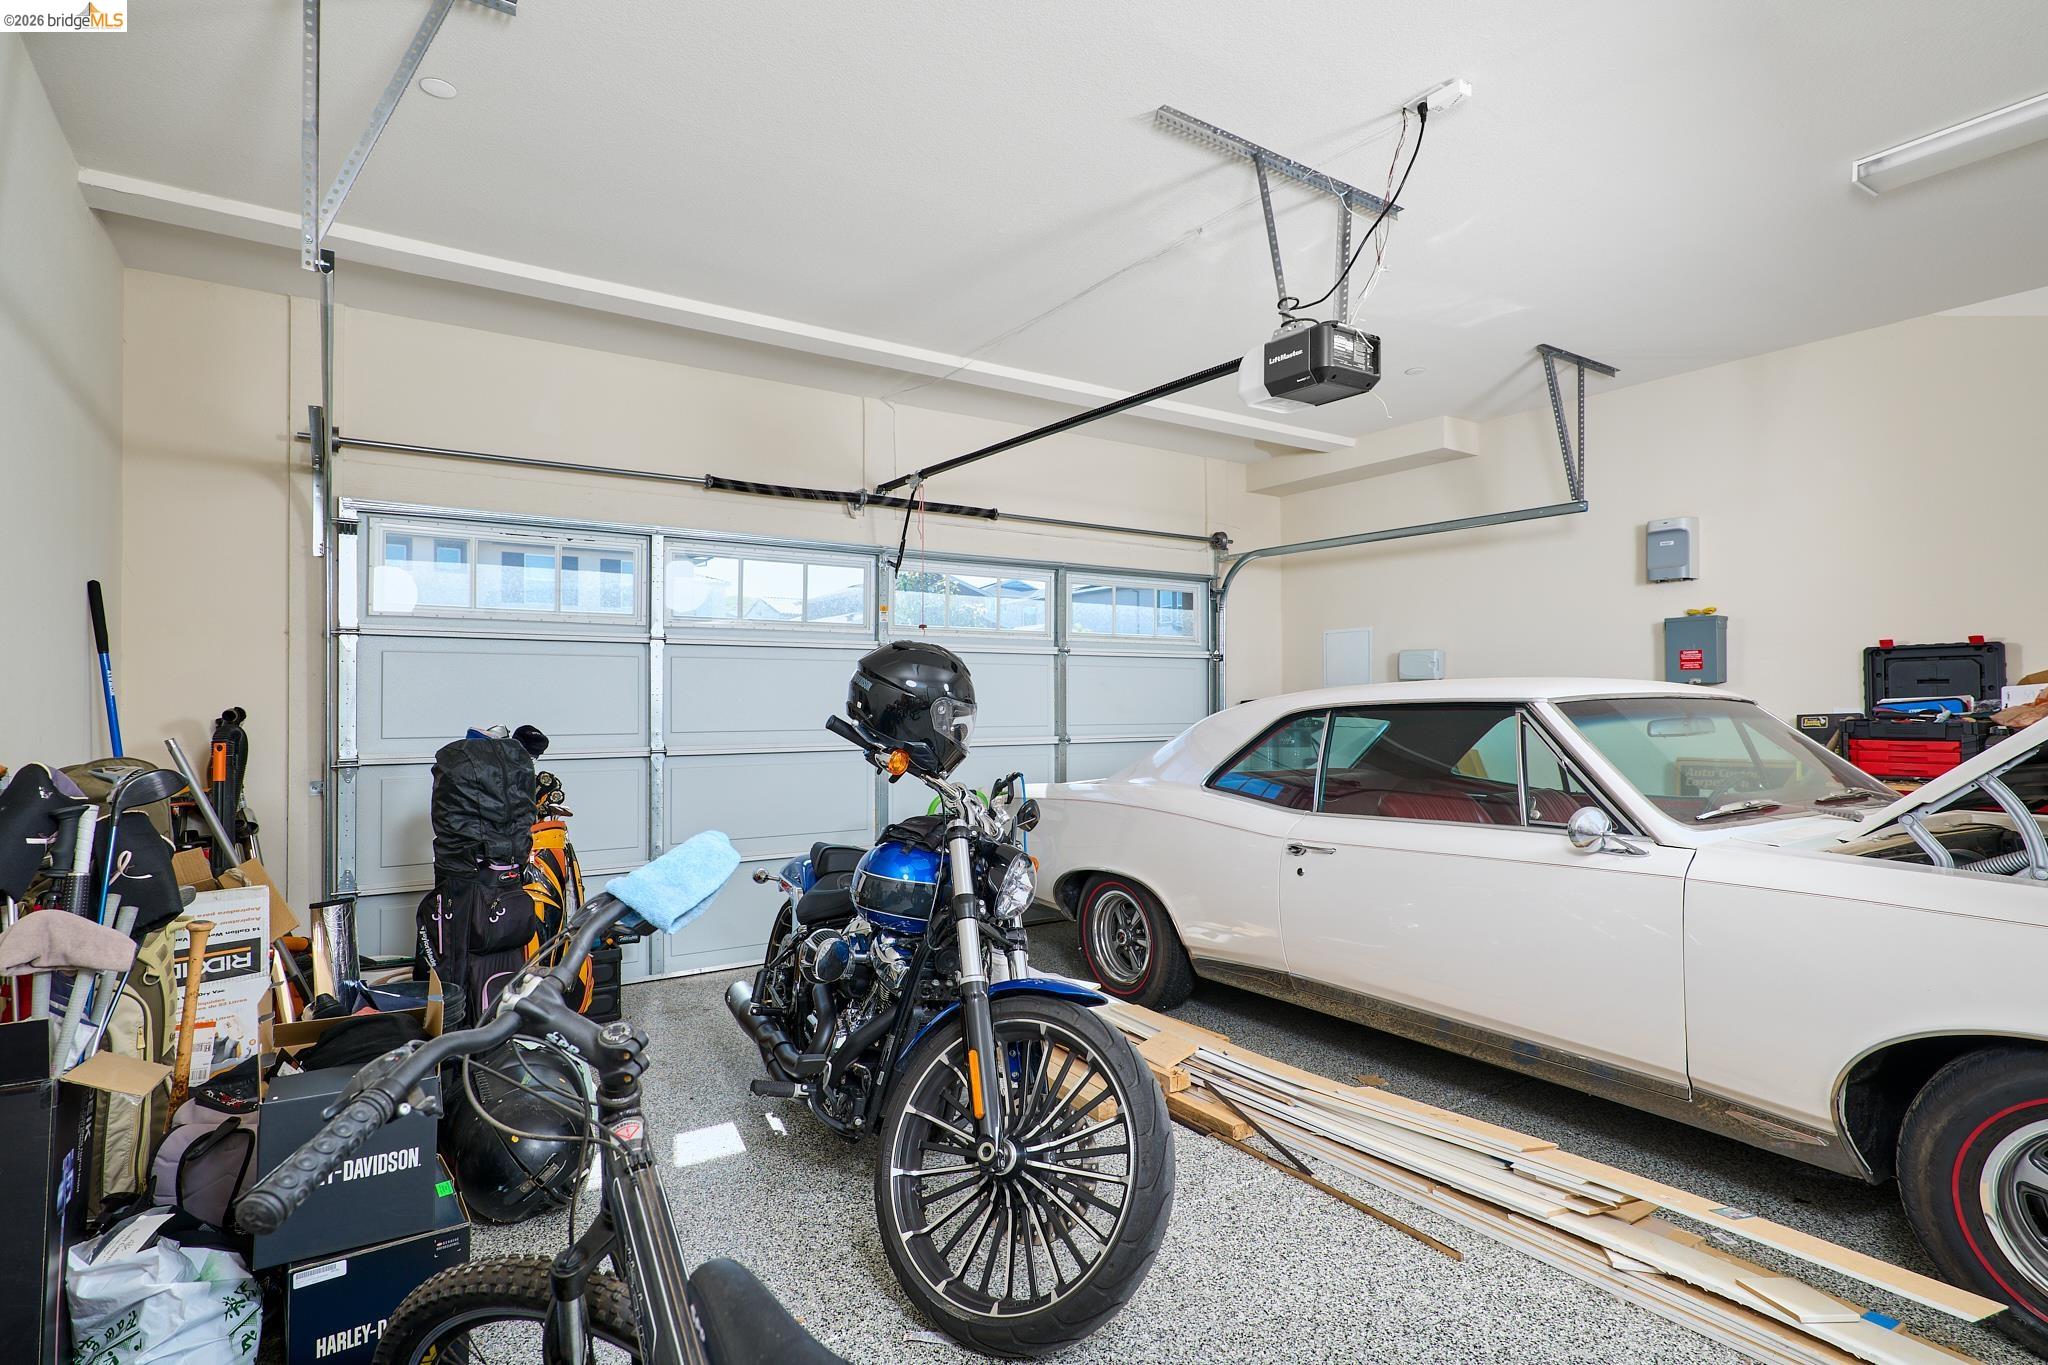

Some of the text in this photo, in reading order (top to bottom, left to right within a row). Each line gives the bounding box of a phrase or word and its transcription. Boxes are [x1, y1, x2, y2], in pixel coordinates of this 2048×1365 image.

[174, 952, 251, 979] RIDI
[320, 1147, 421, 1185] -DAVIDSON.
[316, 1318, 389, 1359] HARLEY-D
